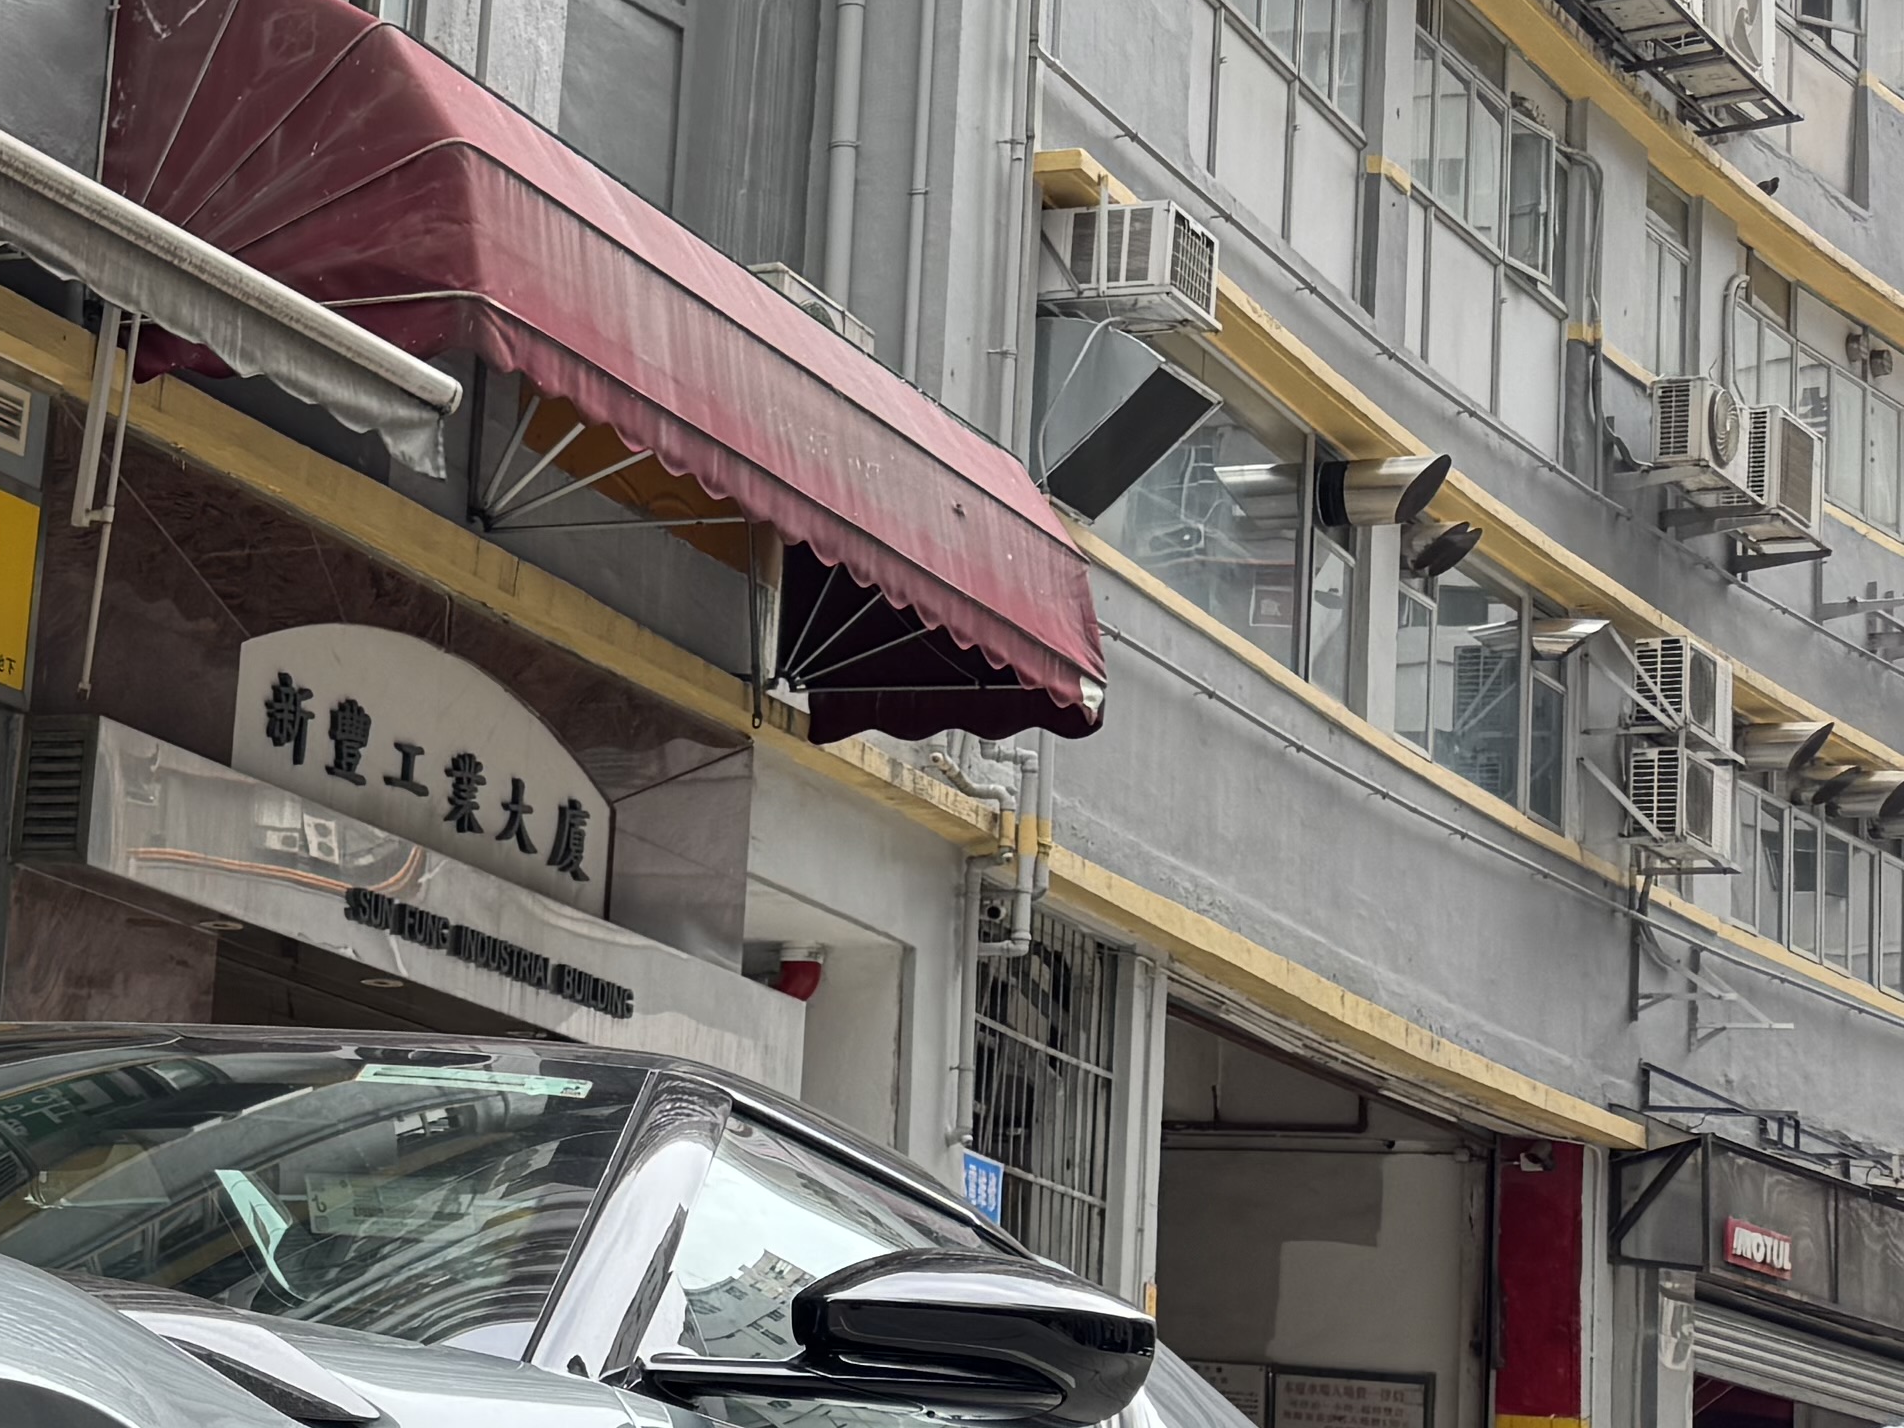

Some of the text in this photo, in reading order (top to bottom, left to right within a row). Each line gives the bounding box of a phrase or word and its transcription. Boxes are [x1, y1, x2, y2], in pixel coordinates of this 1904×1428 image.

[265, 671, 591, 882] 新豐工業大廈
[348, 889, 635, 1020] SUN FUNG INDUSTRIAL BUILDING
[1733, 1226, 1792, 1271] MOTUL
